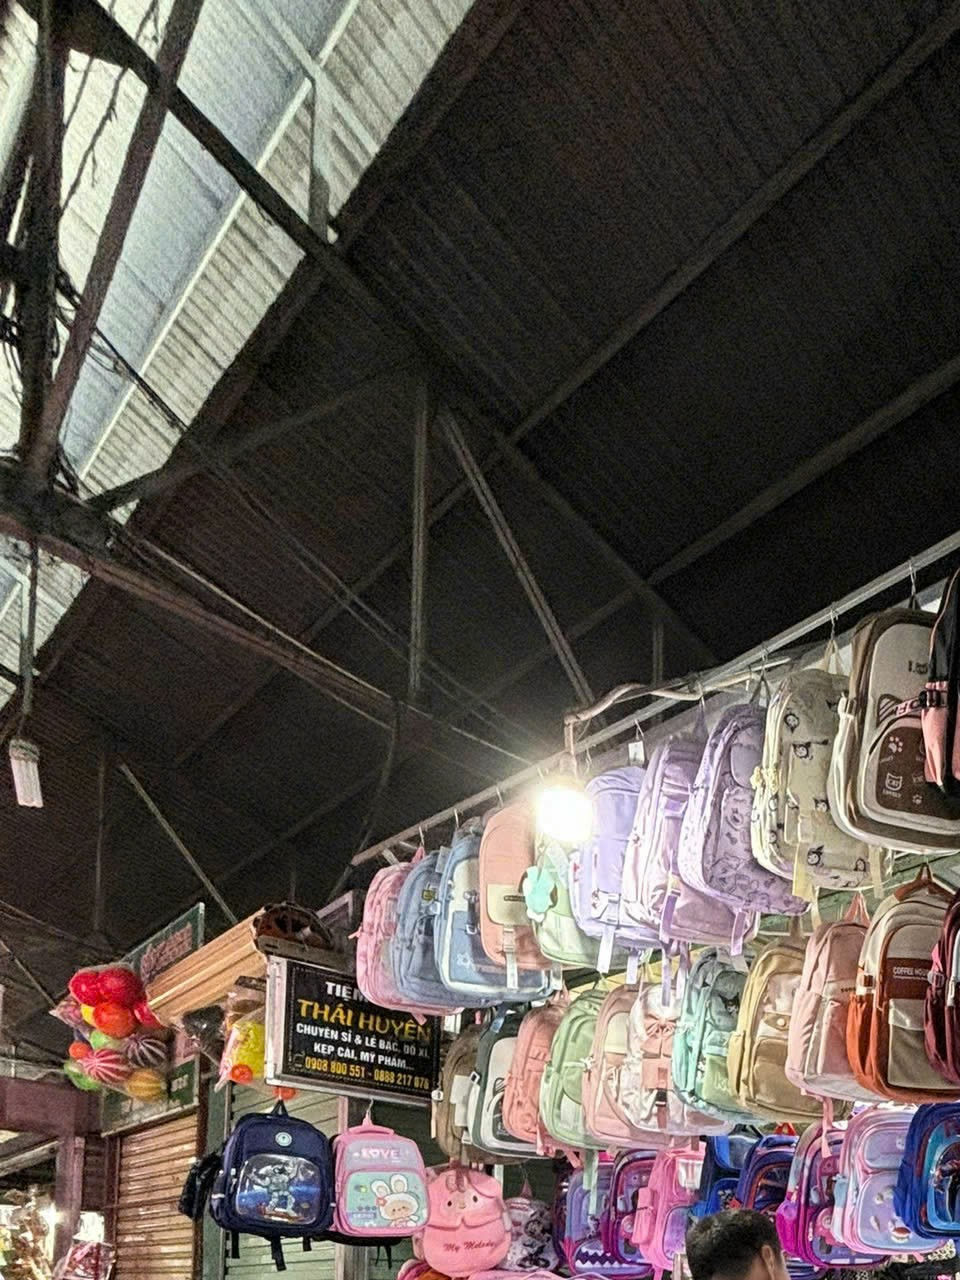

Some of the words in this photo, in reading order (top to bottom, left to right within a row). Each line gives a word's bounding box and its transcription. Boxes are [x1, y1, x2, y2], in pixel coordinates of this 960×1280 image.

[297, 998, 354, 1027] THÁI
[296, 1022, 339, 1041] CHUYÊN
[354, 1034, 362, 1046] &
[348, 1064, 366, 1079] 551
[396, 1072, 413, 1087] 217
[443, 1242, 461, 1254] My
